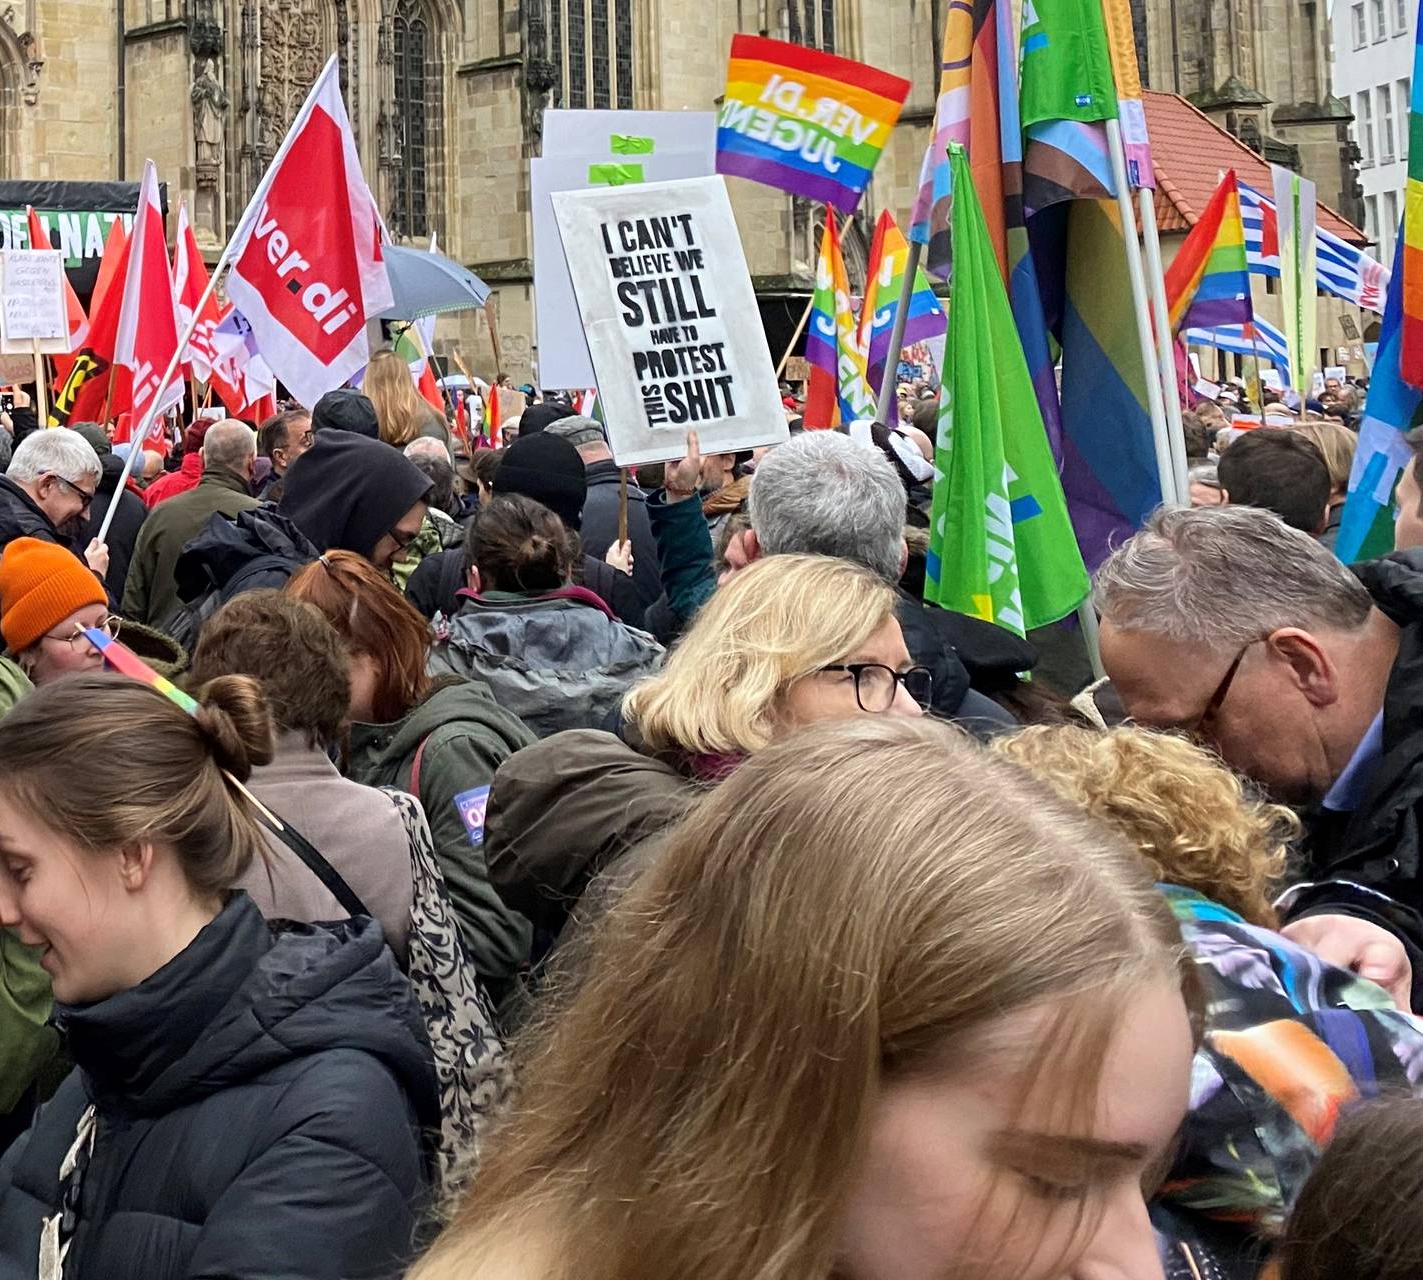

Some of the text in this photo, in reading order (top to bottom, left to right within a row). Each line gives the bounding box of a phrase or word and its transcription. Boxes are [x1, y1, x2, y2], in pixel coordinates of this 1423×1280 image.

[600, 213, 695, 255] I CAN'T
[254, 201, 358, 336] ver.di
[609, 248, 706, 279] BELIEVE WE
[616, 274, 718, 328] STILL
[650, 325, 700, 346] HAVE TO
[632, 342, 728, 381] PROTEST
[640, 383, 668, 428] THIS
[663, 374, 737, 425] SHIT
